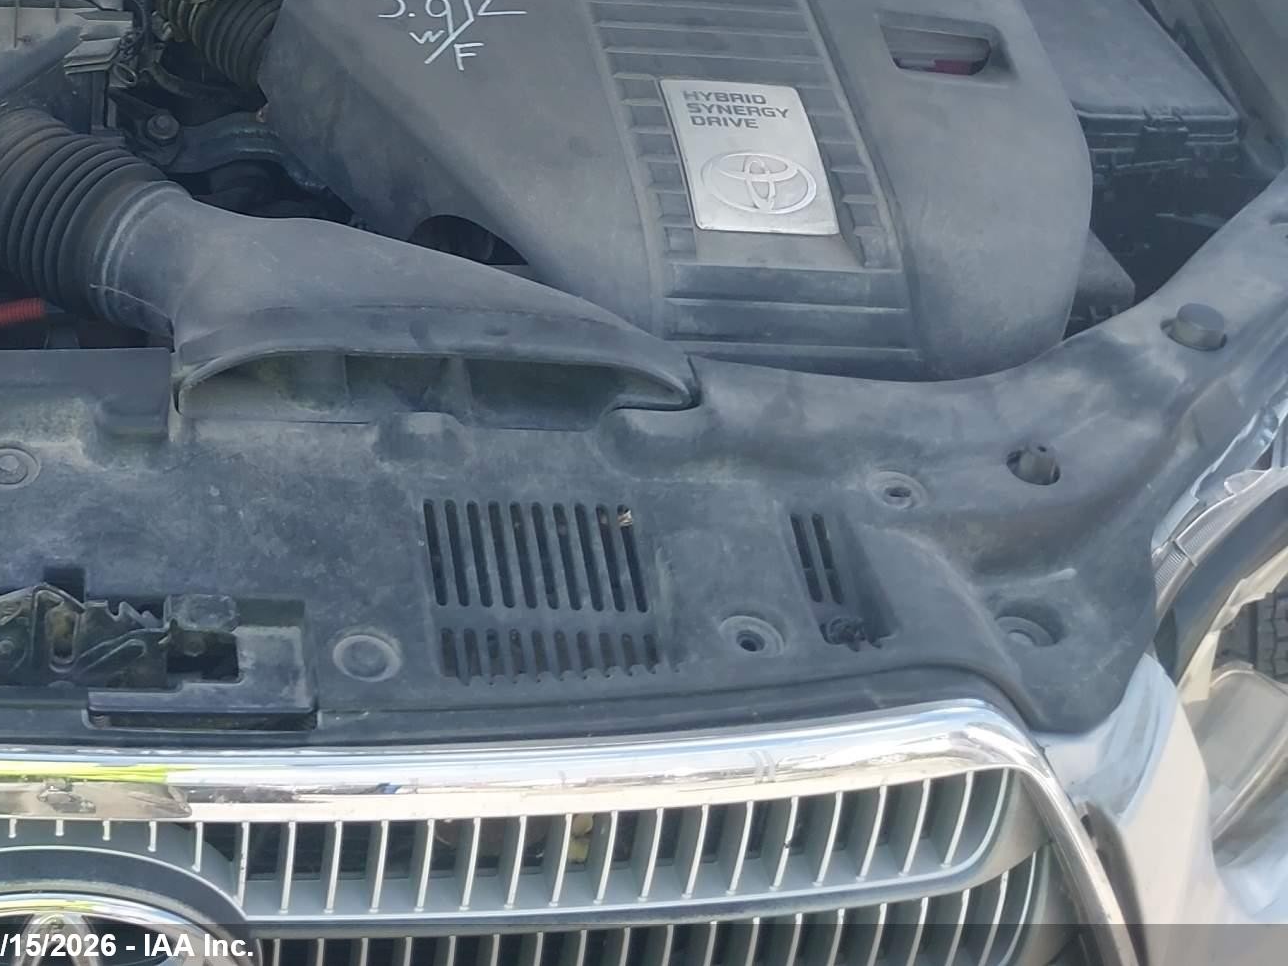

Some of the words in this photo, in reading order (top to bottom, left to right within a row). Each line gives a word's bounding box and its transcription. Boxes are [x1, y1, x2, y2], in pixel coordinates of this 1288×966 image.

[683, 90, 767, 105] HYBRID
[686, 103, 790, 119] SYNERGY
[690, 115, 759, 129] DRIVE
